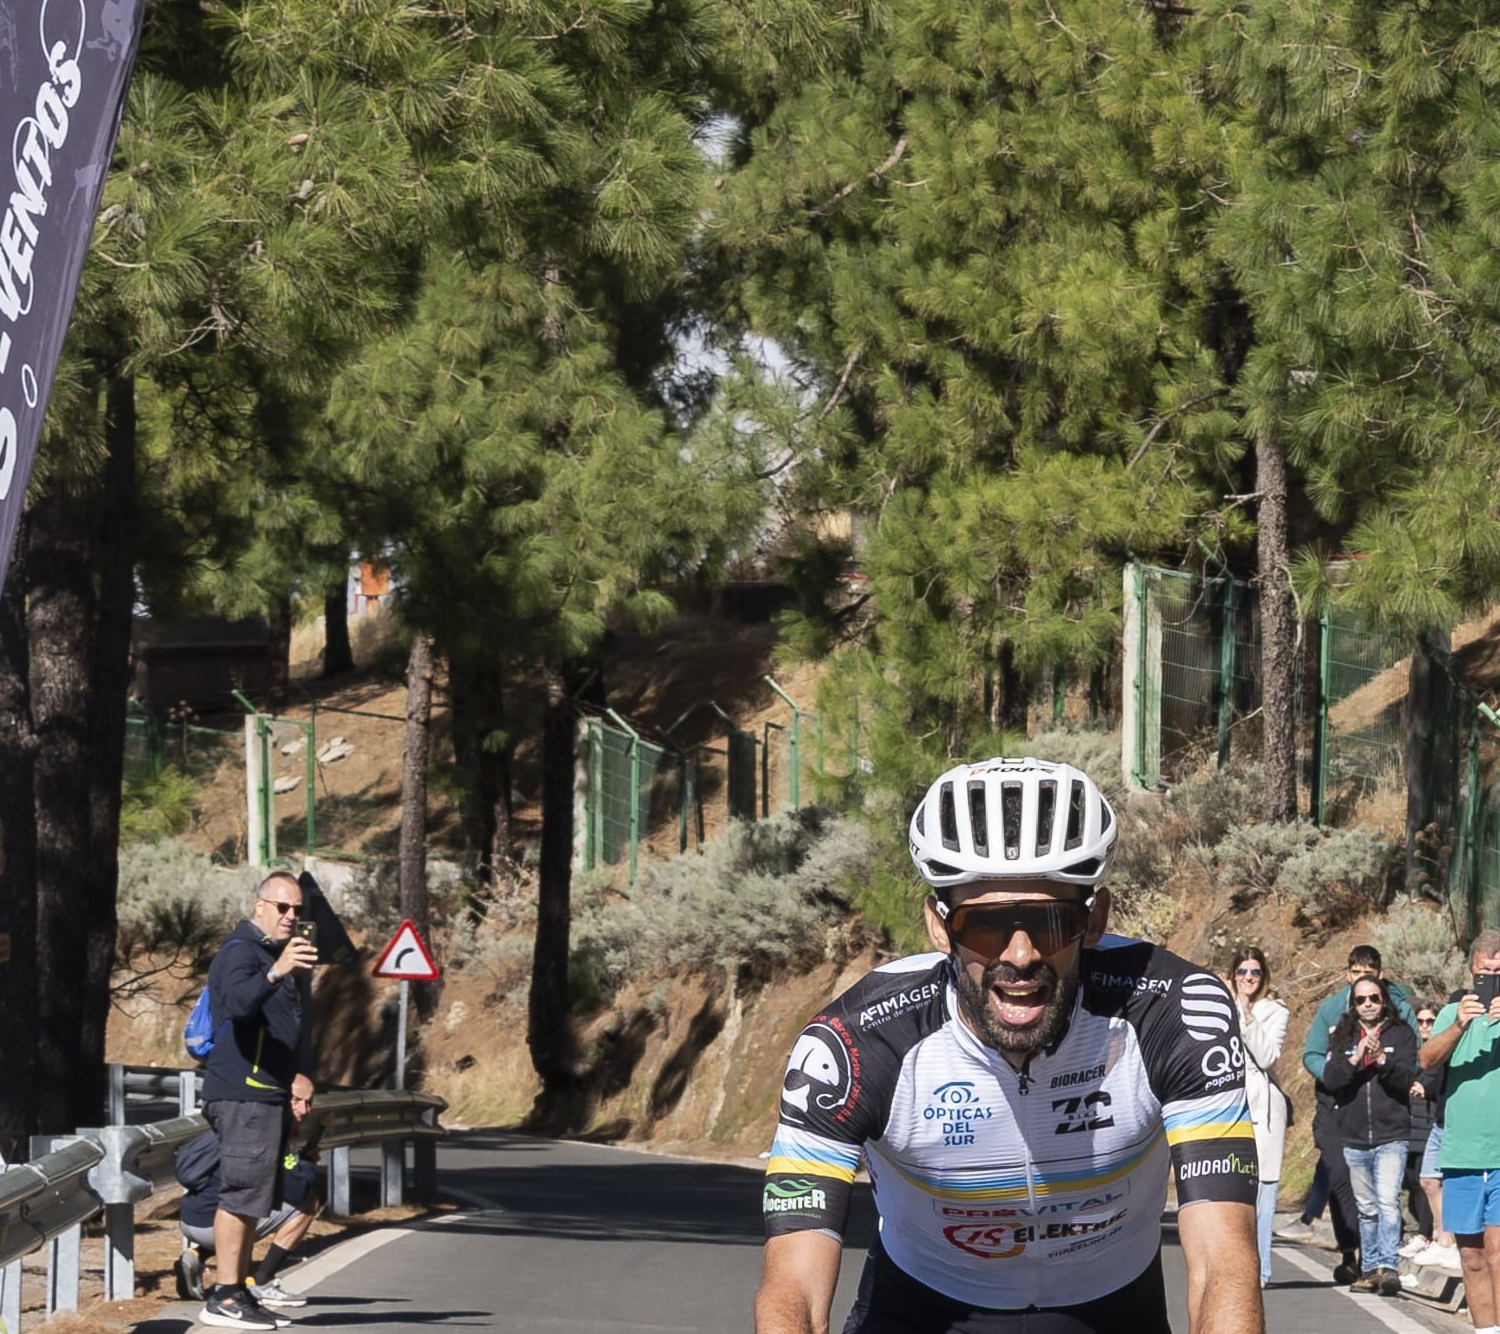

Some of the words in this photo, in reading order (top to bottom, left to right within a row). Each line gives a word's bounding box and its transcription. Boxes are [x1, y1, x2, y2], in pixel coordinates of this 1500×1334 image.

[1050, 1064, 1107, 1089] BIORACER
[923, 1104, 993, 1121] ÓPTICAS
[942, 1121, 975, 1134] DEL
[944, 1134, 975, 1147] SUR
